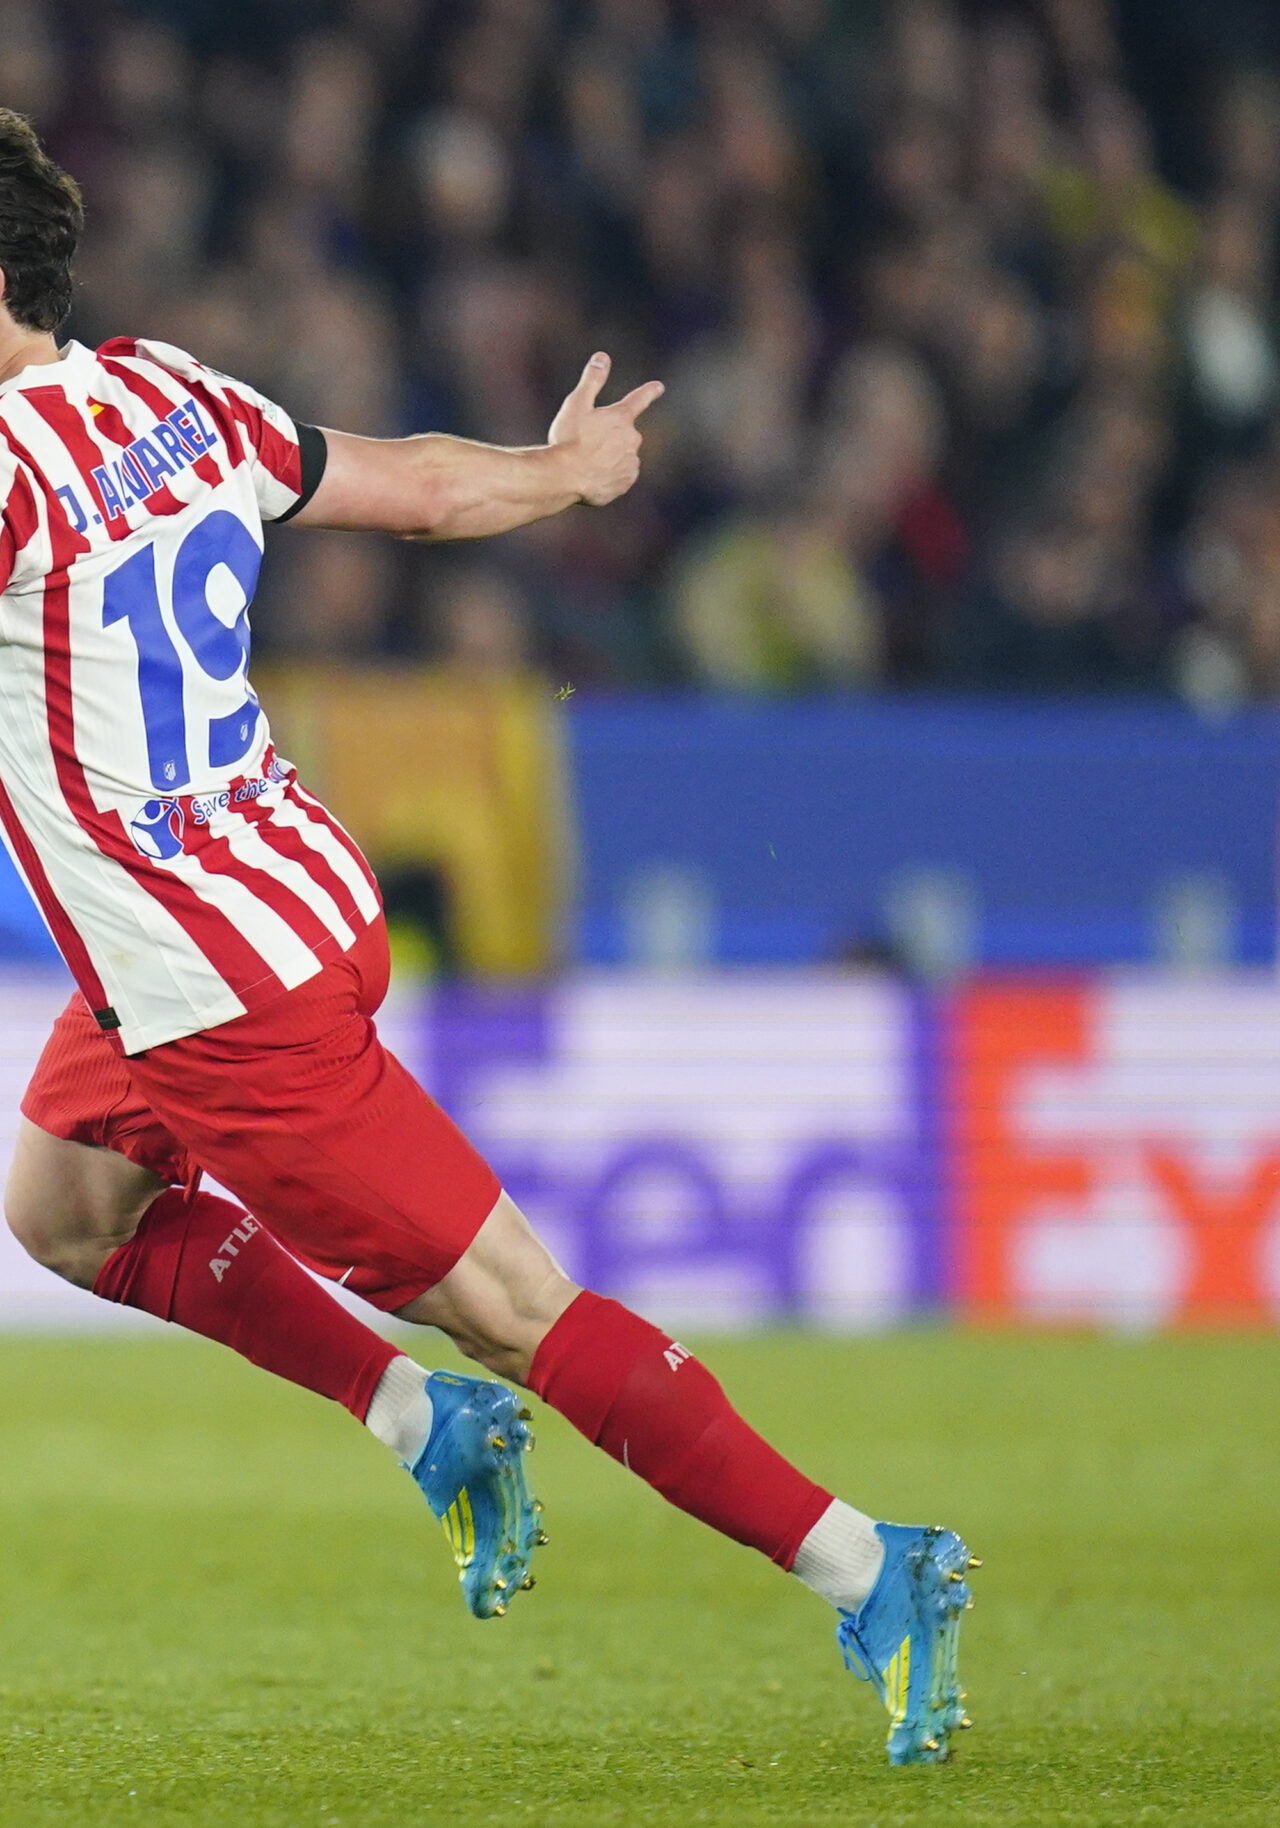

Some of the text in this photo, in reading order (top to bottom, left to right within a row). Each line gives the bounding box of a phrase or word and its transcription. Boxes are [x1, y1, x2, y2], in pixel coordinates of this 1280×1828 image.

[101, 509, 265, 793] 19
[190, 776, 269, 825] Save the
